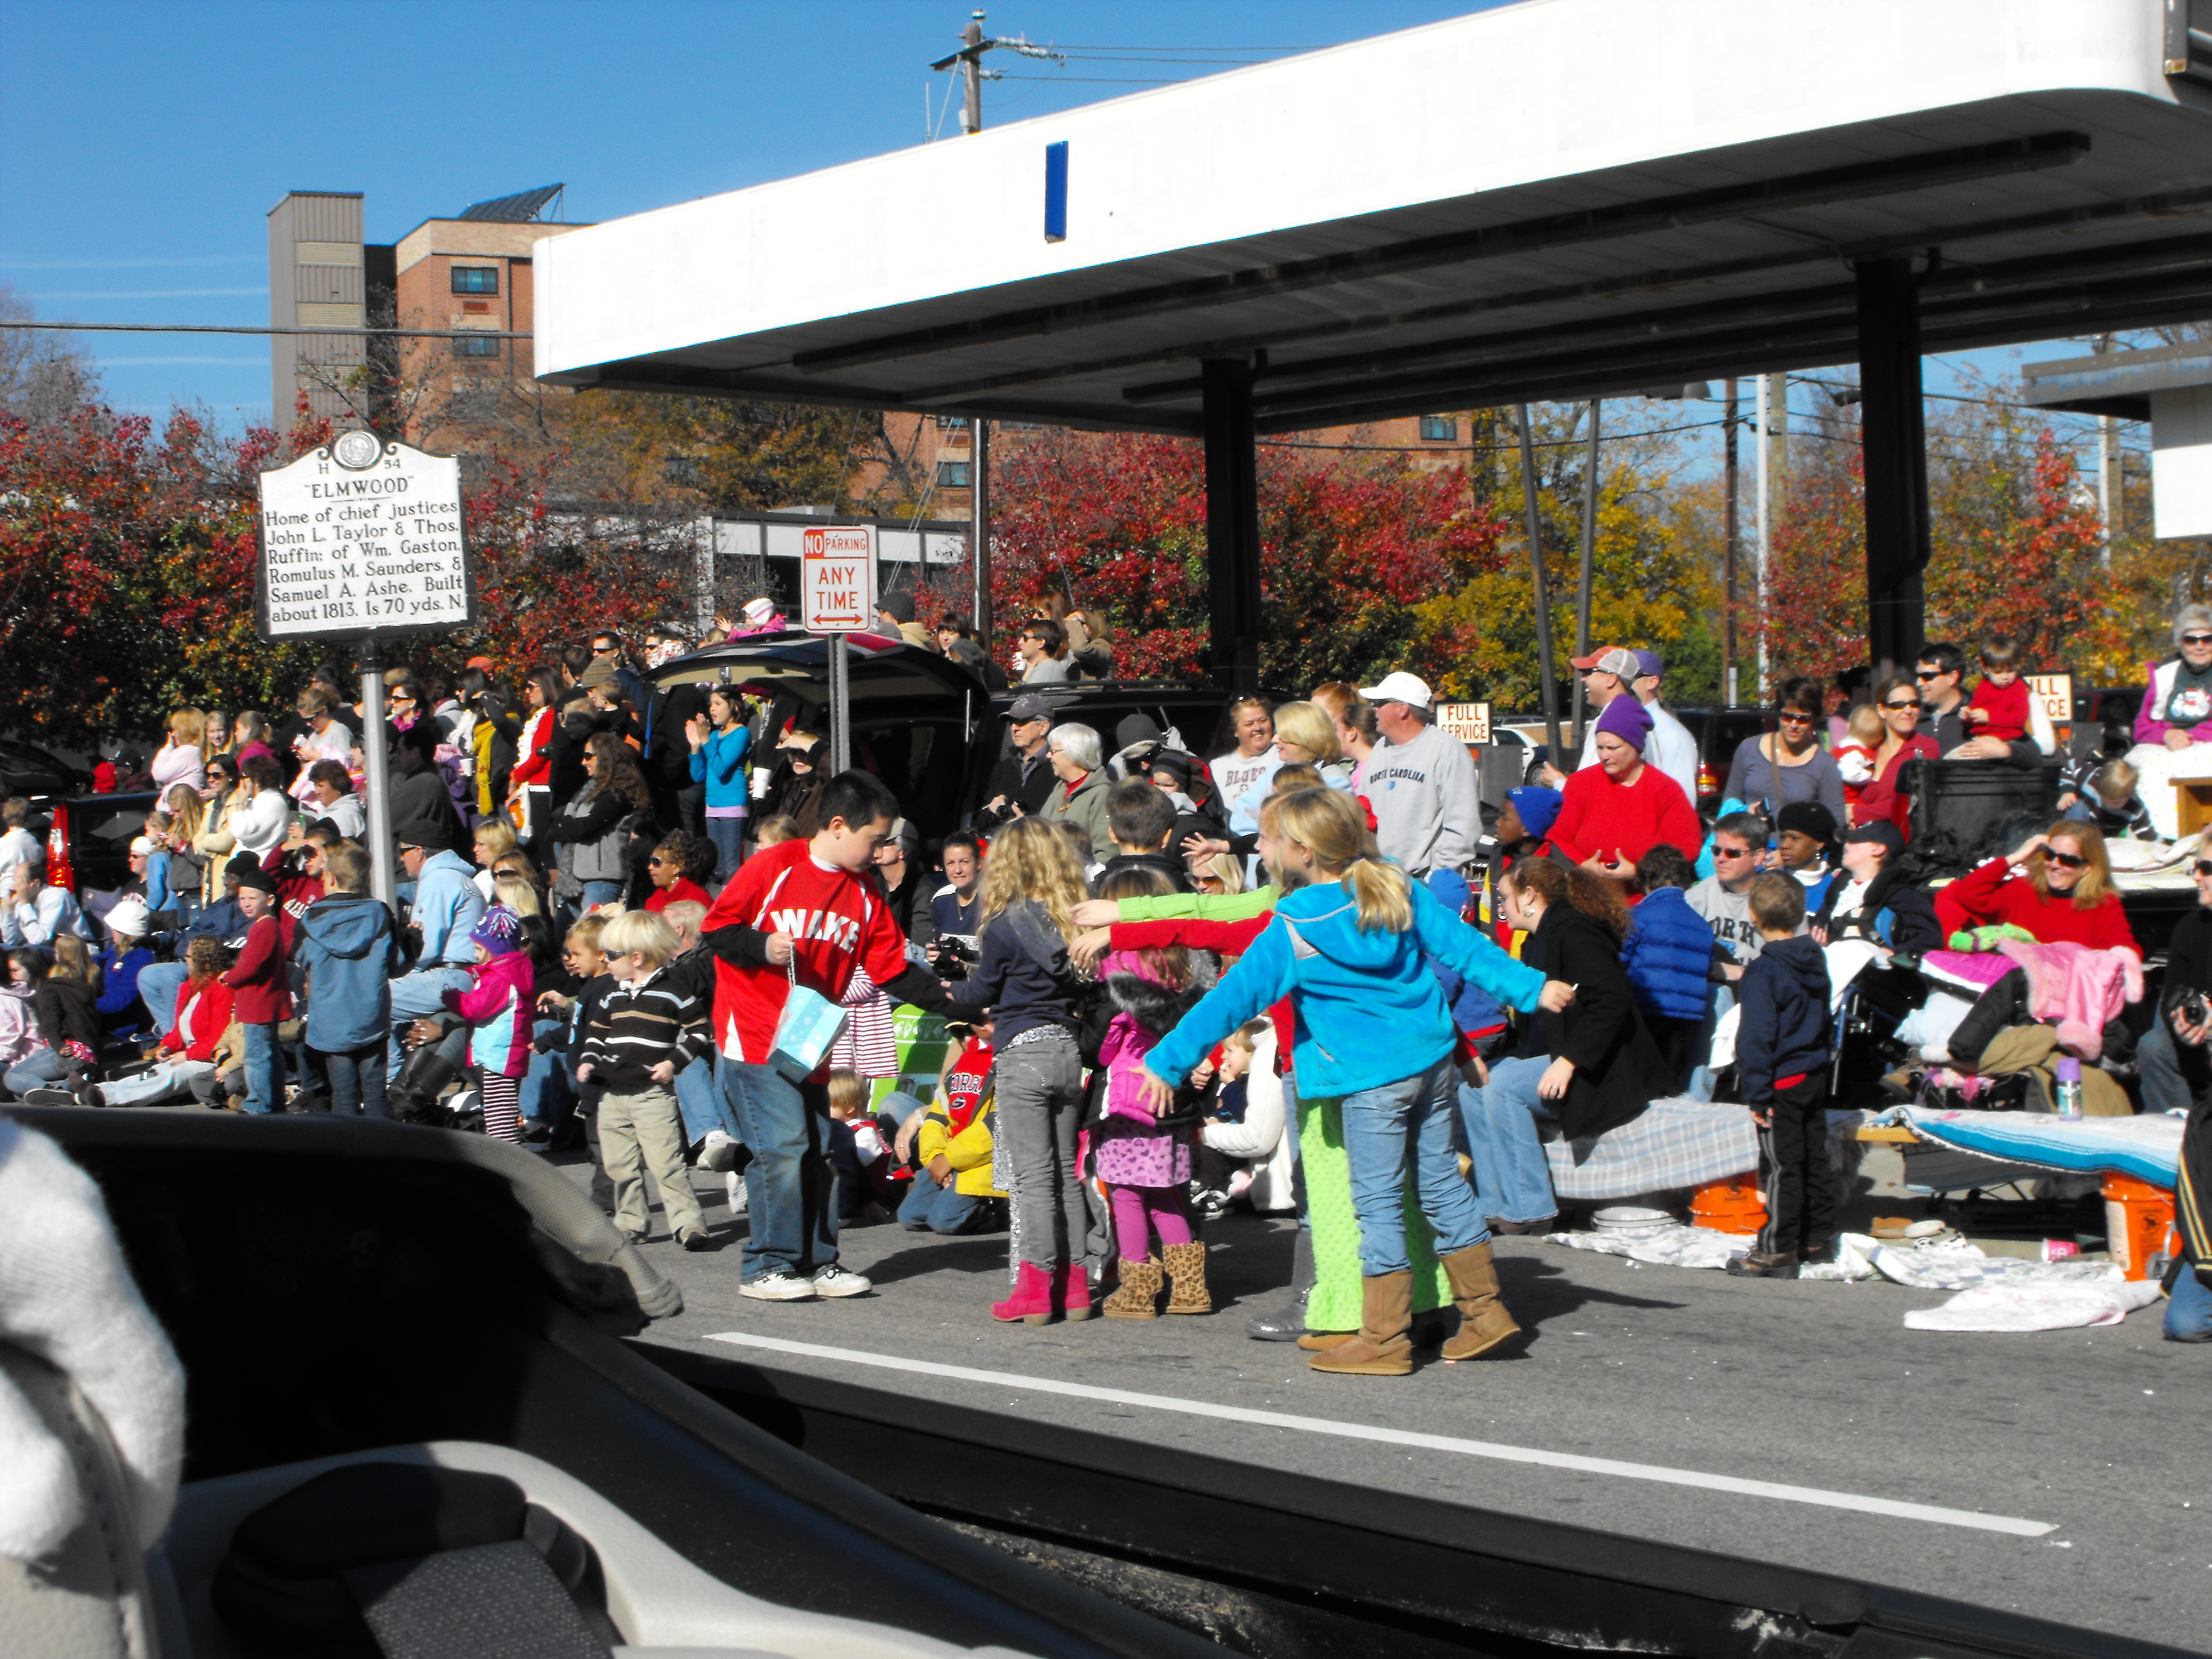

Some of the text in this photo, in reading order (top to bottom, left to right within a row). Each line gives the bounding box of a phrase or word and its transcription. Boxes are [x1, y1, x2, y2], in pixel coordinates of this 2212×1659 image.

[318, 458, 401, 474] H 54
[265, 501, 458, 526] Home of chief justices
[267, 518, 459, 545] John L. Taylor & Thos.
[268, 548, 323, 565] Ruffin:
[332, 545, 350, 560] of
[359, 542, 392, 557] Wm.
[805, 535, 866, 554] NO PARKING
[269, 566, 336, 584] Romulus
[341, 563, 360, 578] M.
[452, 556, 461, 571] &
[819, 567, 855, 585] ANY
[270, 575, 463, 603] Samuel A. Ashe. Built
[817, 592, 858, 609] TIME
[272, 594, 465, 622] about 1813. Is 70 yds. N.
[2029, 678, 2059, 695] LL
[1447, 705, 1481, 720] FULL
[1390, 768, 1425, 783] CAROLINA
[770, 909, 860, 954] WAKE
[1708, 916, 1756, 948] ORTH
